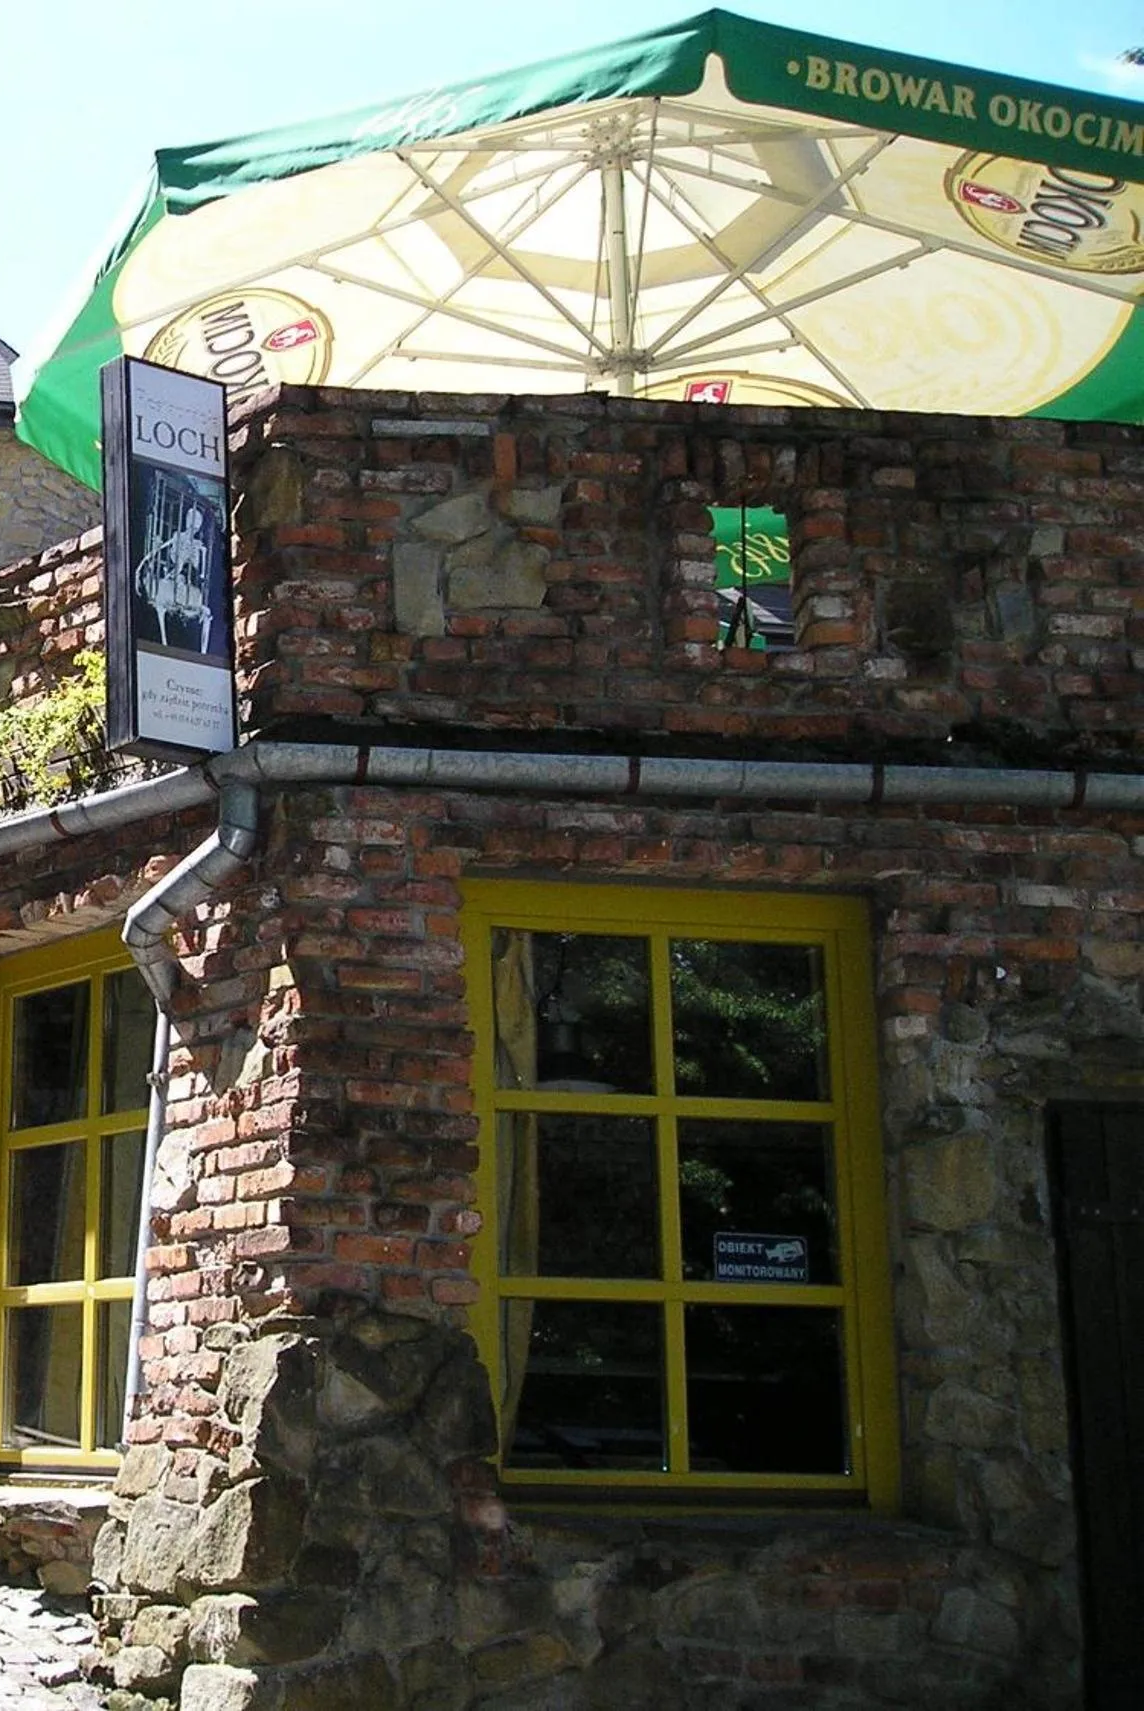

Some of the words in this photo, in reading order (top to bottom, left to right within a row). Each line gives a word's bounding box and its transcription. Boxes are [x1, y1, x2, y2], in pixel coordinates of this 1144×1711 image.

[805, 56, 977, 121] BROWAR
[988, 94, 1144, 157] OKOCIM
[135, 414, 221, 462] LOCH
[717, 1241, 765, 1255] OBIEKT
[717, 1263, 806, 1279] MONITOROWANY
